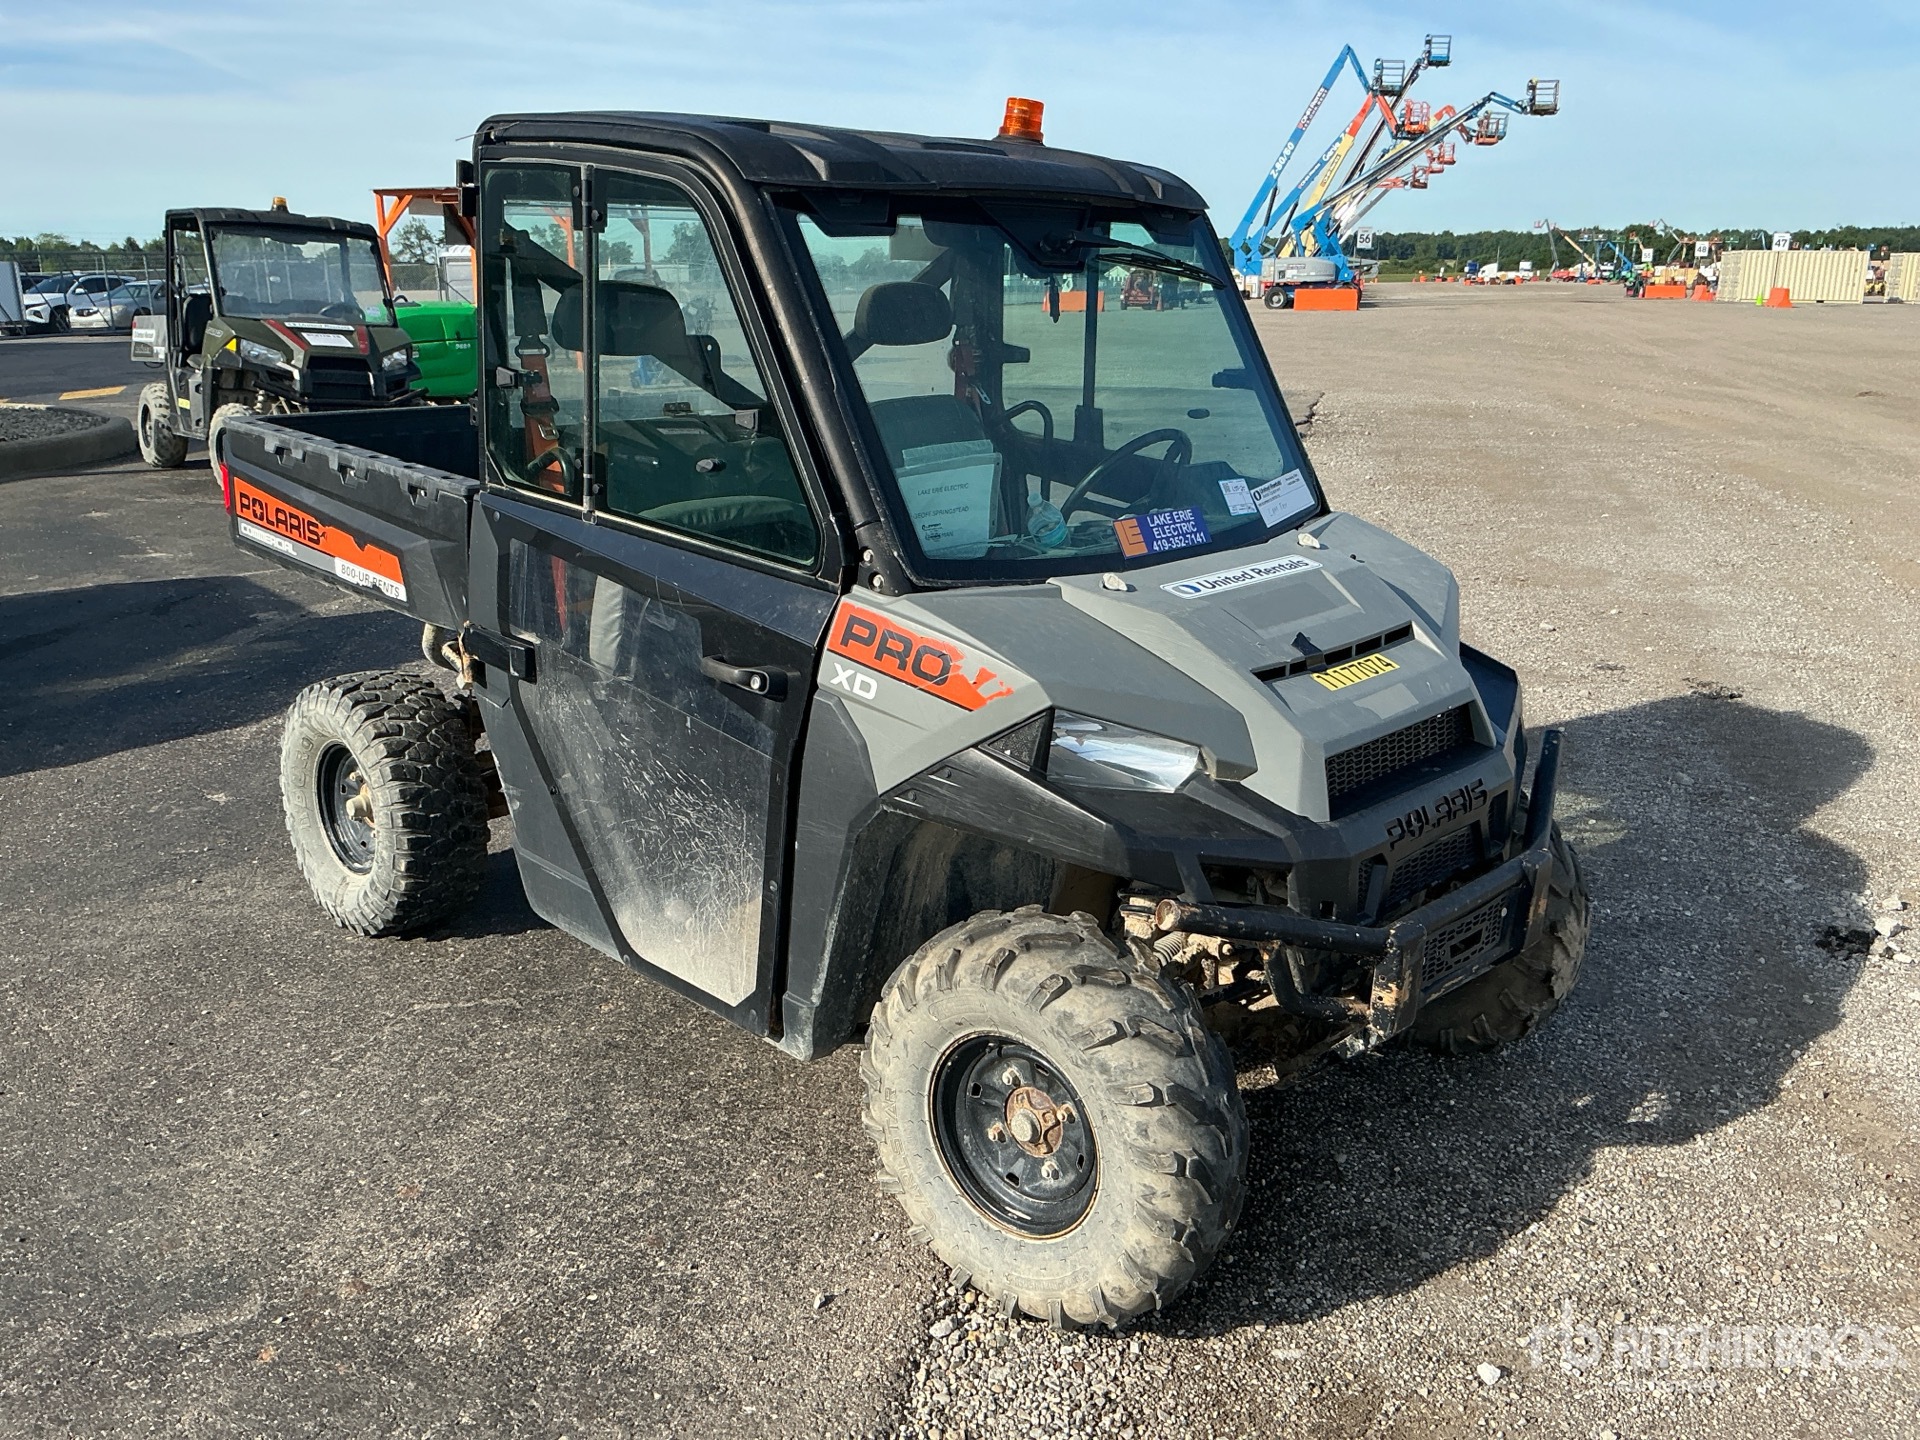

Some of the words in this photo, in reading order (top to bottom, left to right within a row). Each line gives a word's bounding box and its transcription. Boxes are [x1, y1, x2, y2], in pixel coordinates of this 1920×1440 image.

[1270, 141, 1295, 179] Z-80/60
[1322, 141, 1341, 162] Genie
[1358, 233, 1371, 244] 56
[1696, 245, 1707, 253] 48
[1774, 238, 1788, 248] 47
[917, 488, 931, 496] LAKE
[931, 486, 944, 495] ERIE
[943, 482, 969, 492] ELECTRIC
[239, 491, 321, 546] POLARIS
[1146, 512, 1172, 527] LAKE
[1173, 509, 1195, 523] ERIE
[1153, 521, 1197, 539] ELECTRIC
[1152, 531, 1207, 552] 419-352-7141
[341, 563, 400, 598] 800-UR-RENTS
[1197, 571, 1254, 590] United
[1252, 558, 1310, 579] Rentals
[839, 613, 951, 686] PRO
[830, 662, 878, 700] XD
[1383, 777, 1488, 852] POLARIS
